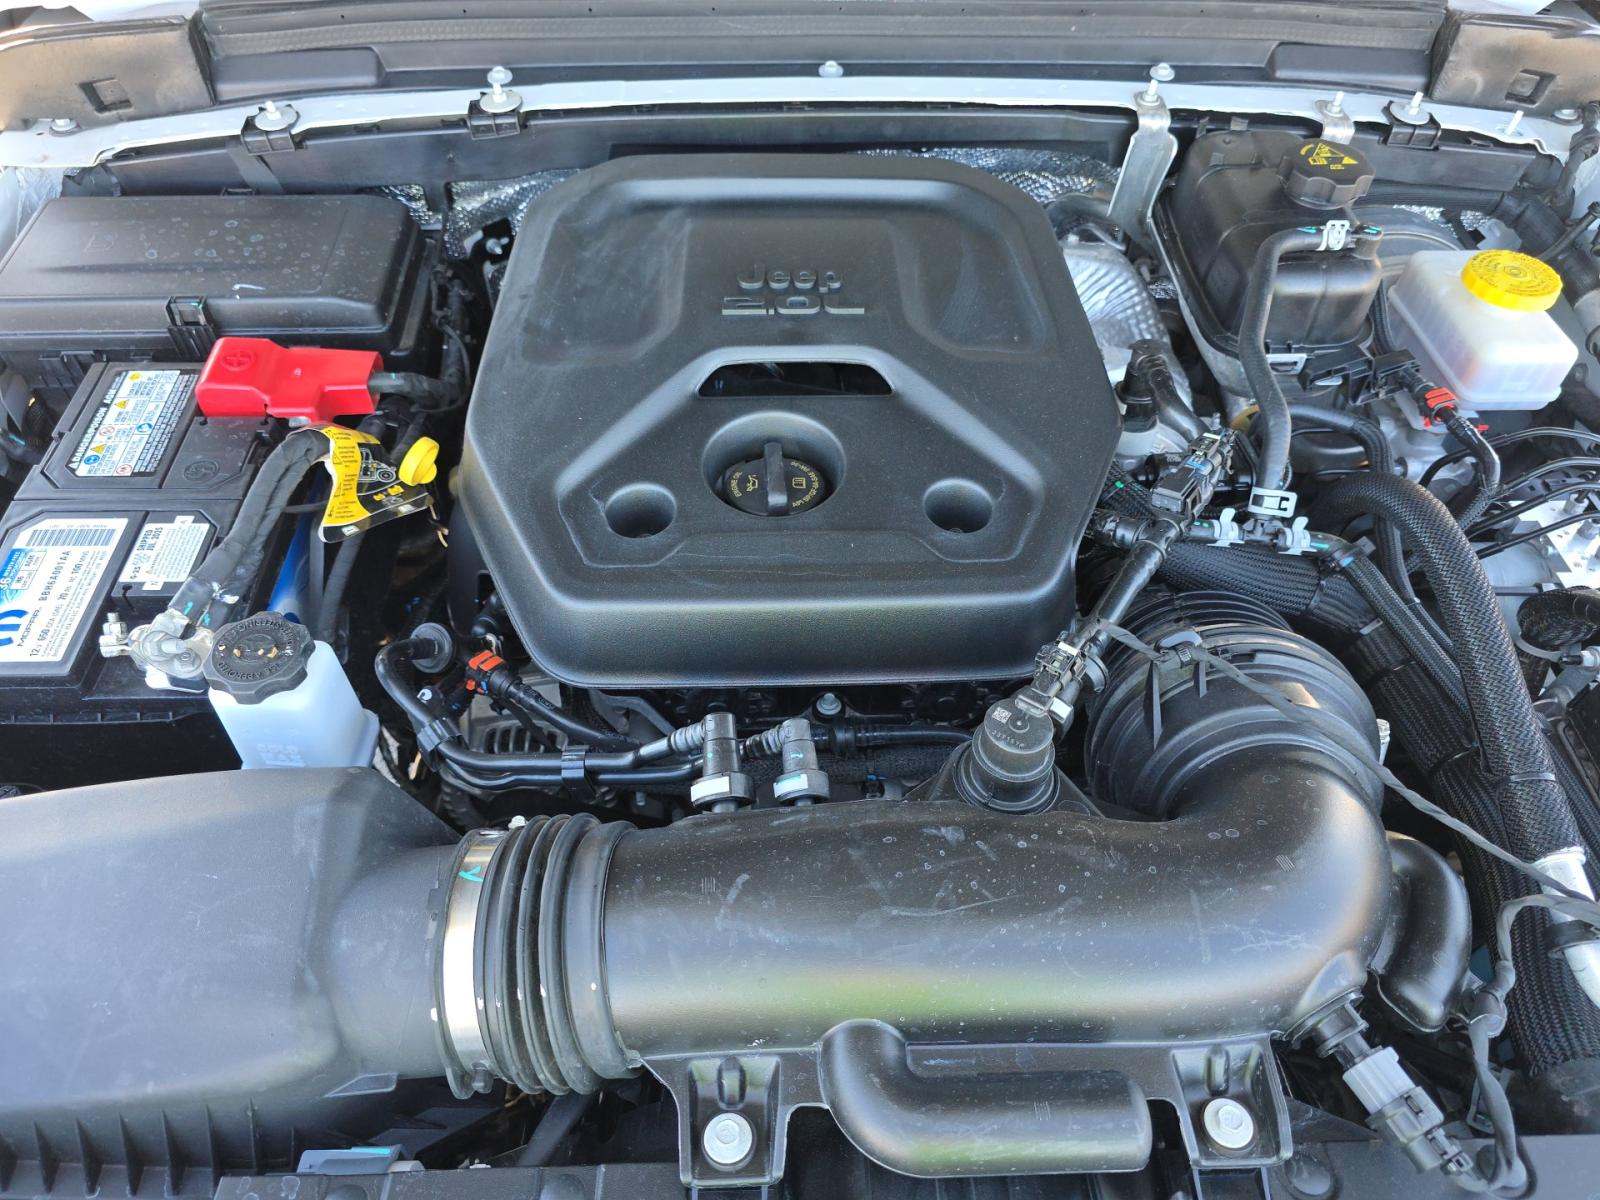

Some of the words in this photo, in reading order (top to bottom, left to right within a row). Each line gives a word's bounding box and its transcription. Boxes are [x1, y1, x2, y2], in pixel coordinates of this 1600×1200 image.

[736, 264, 842, 293] Jeep
[721, 297, 865, 315] 2.0L
[17, 608, 40, 647] MOPAR
